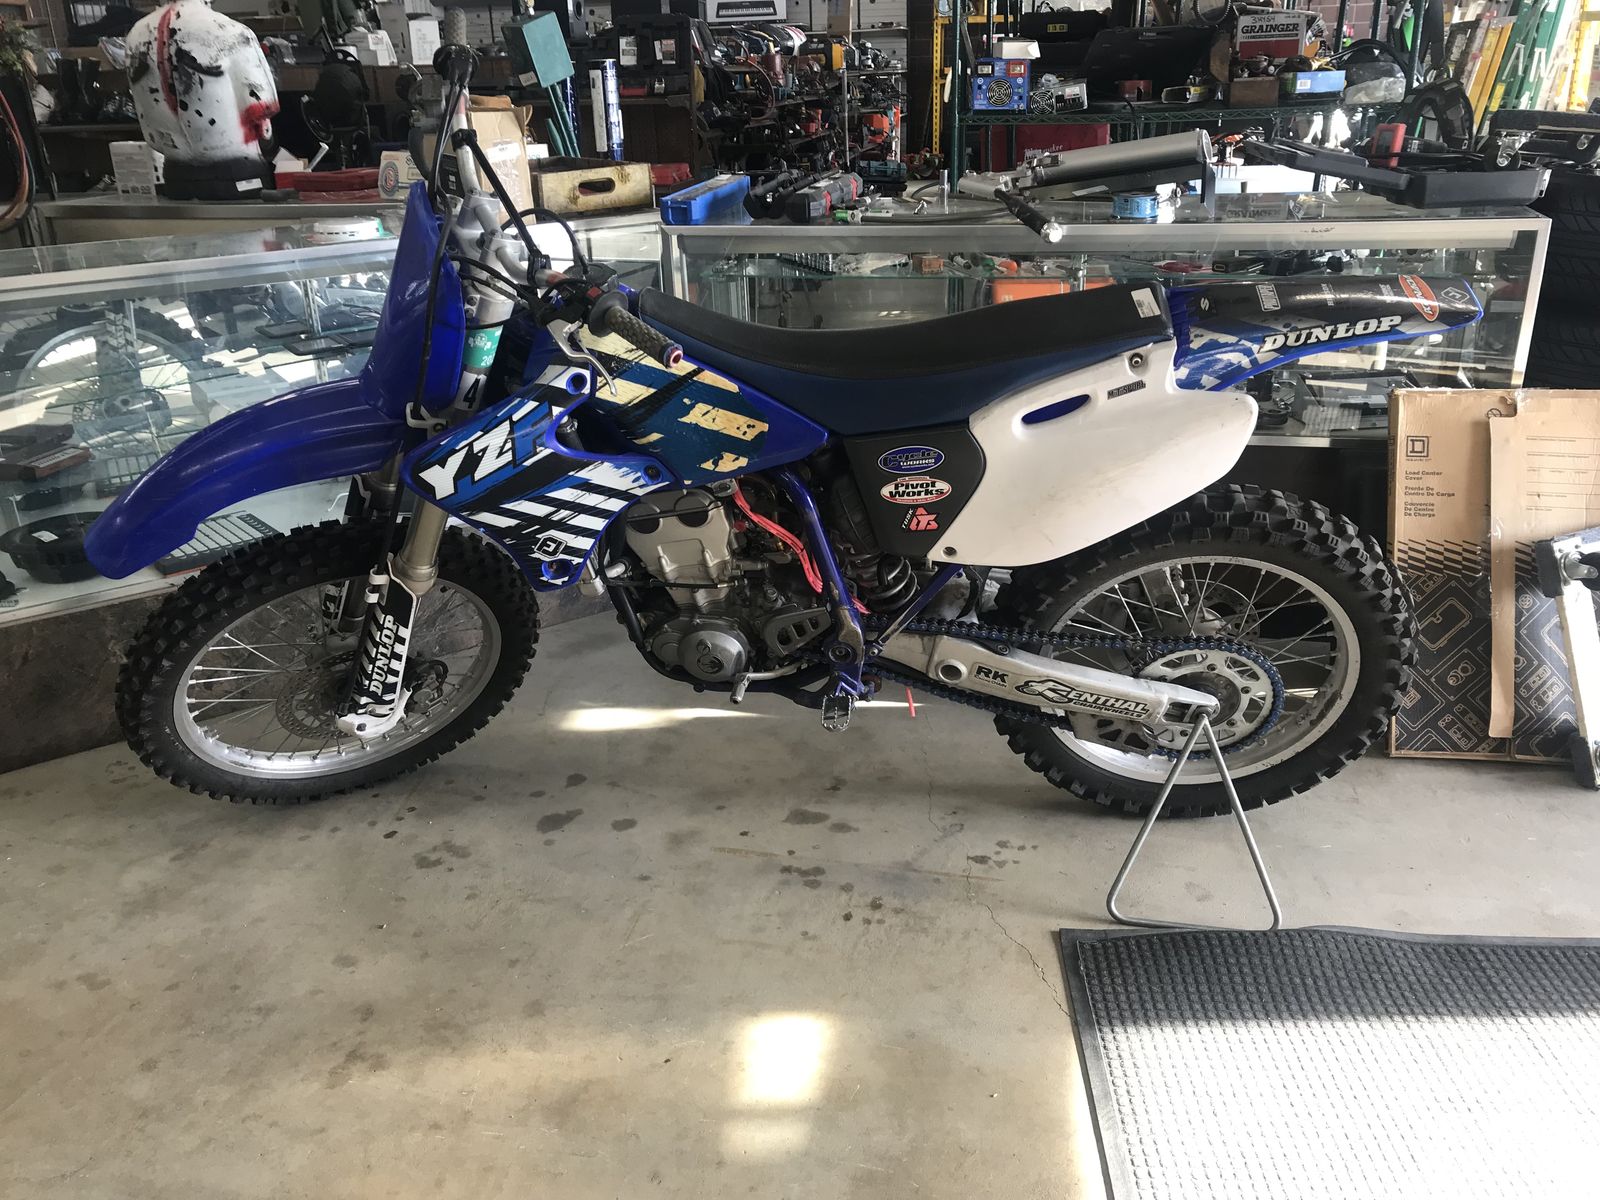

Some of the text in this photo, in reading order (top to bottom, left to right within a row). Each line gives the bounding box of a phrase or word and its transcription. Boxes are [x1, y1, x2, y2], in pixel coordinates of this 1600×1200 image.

[1241, 23, 1299, 34] GRAINGER
[1257, 315, 1402, 354] DUNLOP
[888, 489, 944, 498] Works
[894, 481, 936, 490] Pivot
[902, 508, 914, 529] TUSK
[369, 614, 397, 696] DUNLOP
[976, 665, 1009, 684] RK
[1072, 700, 1143, 718] CHAINWHEELS
